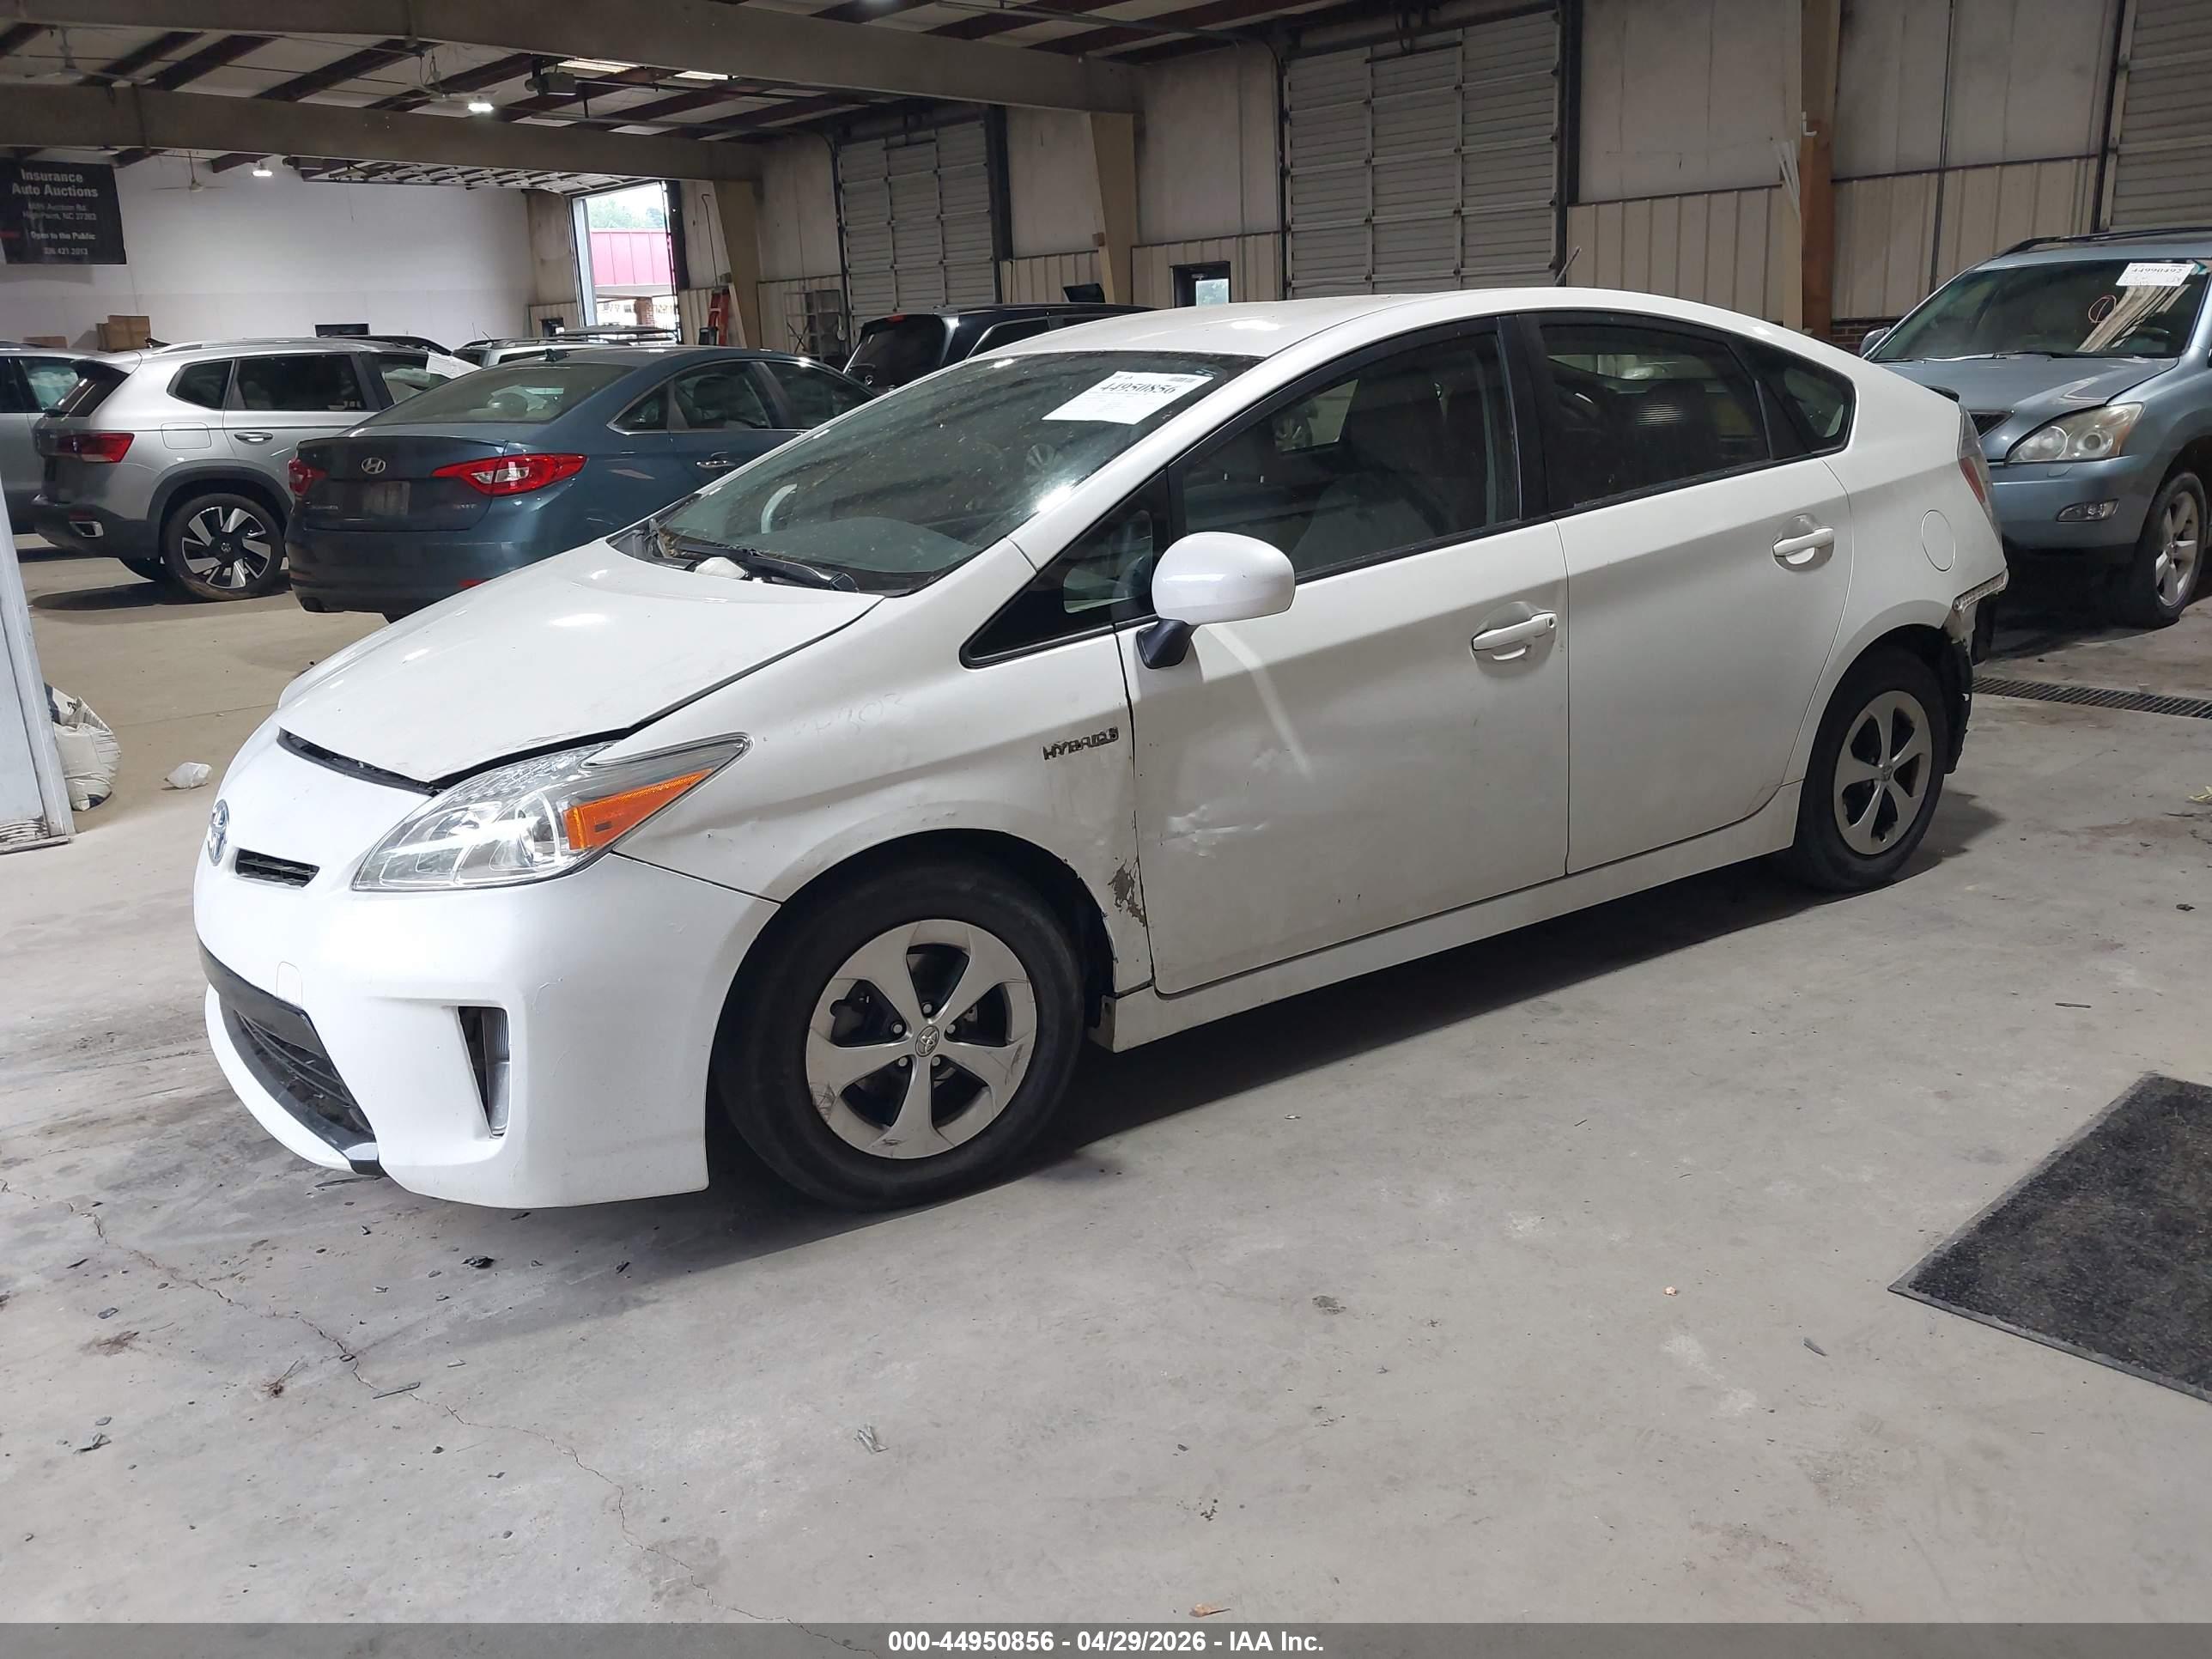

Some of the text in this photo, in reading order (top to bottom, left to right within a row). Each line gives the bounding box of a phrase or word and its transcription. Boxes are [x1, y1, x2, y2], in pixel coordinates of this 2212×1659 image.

[21, 169, 83, 183] Insurance
[12, 183, 99, 198] Auto Auctions
[31, 230, 49, 240] Open
[59, 232, 71, 240] the
[72, 232, 96, 240] Public
[1100, 383, 1177, 394] 44950856
[1042, 729, 1110, 761] HYBRID
